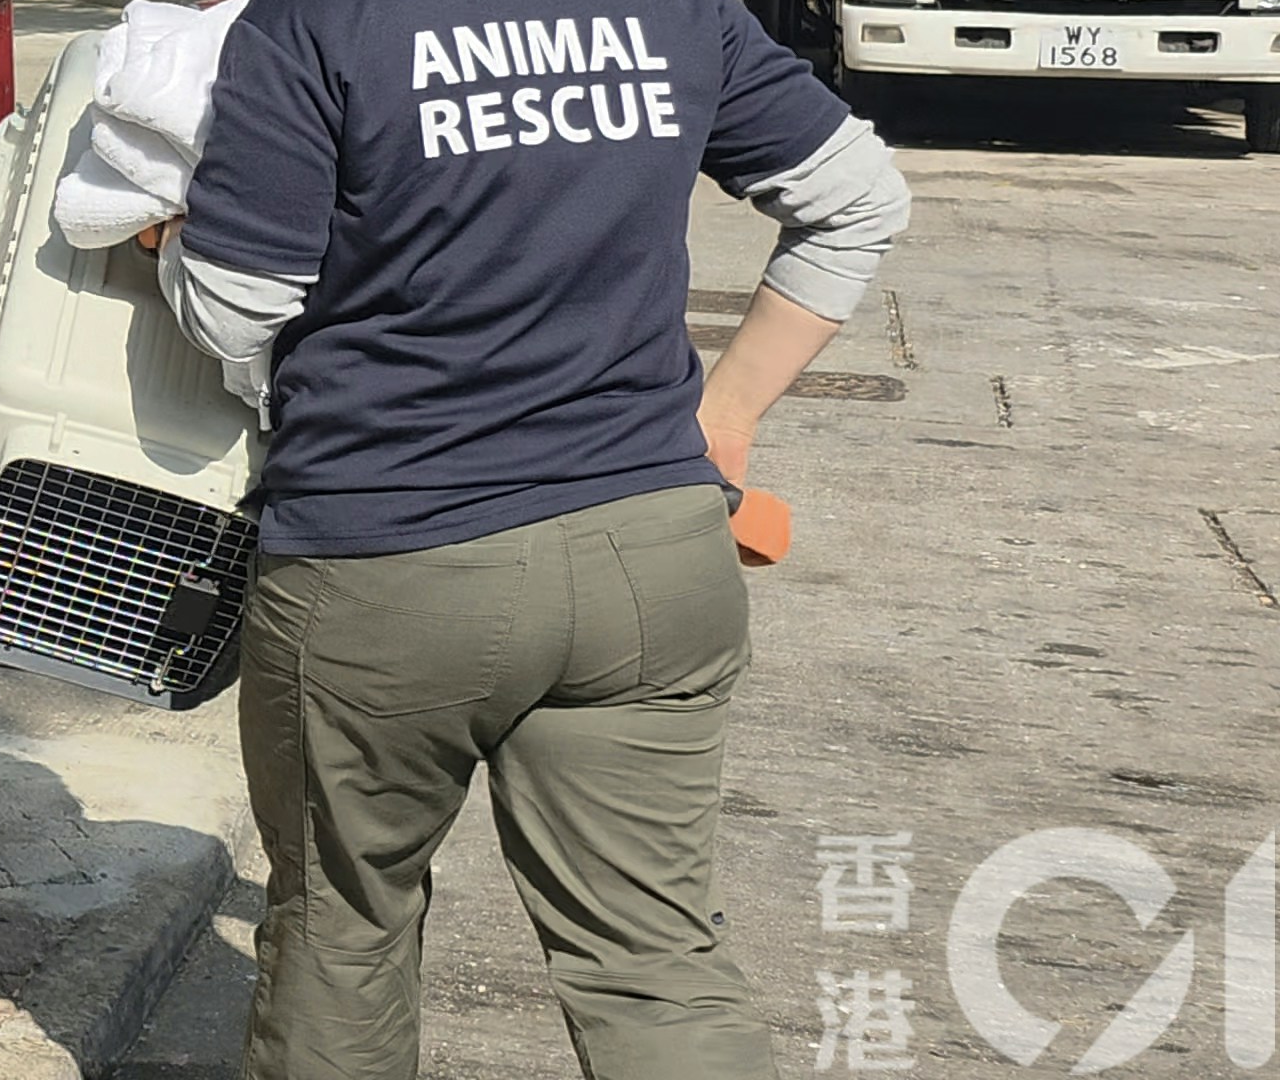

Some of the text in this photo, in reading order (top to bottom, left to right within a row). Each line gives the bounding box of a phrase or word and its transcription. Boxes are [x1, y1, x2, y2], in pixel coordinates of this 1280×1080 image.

[412, 17, 668, 90] ANIMAL
[1050, 47, 1118, 67] 1568
[1065, 26, 1102, 46] WY
[419, 82, 680, 159] RESCUE
